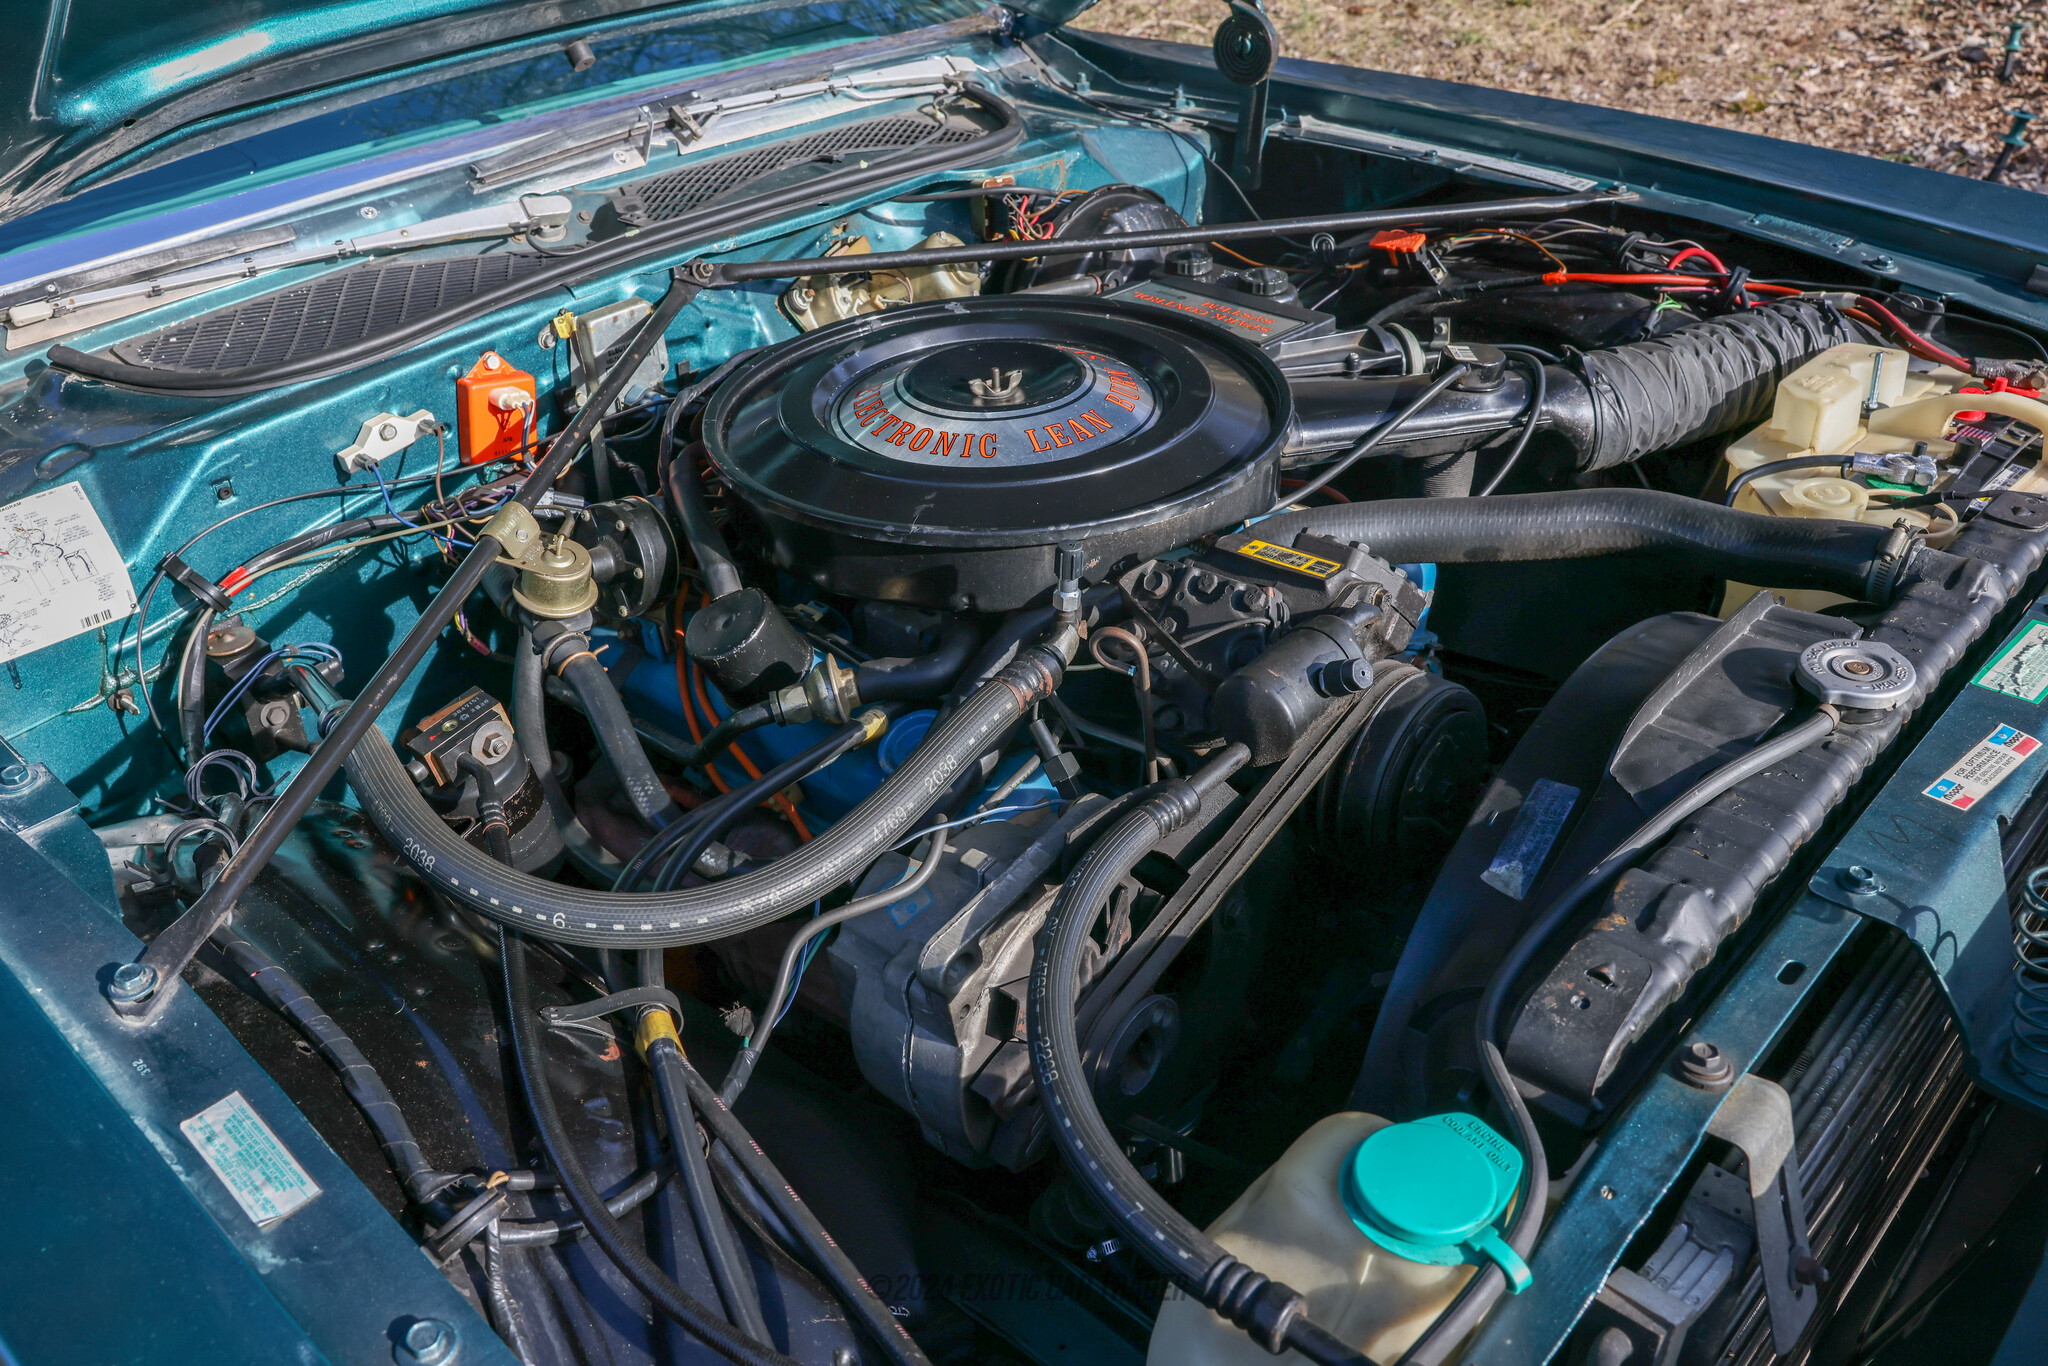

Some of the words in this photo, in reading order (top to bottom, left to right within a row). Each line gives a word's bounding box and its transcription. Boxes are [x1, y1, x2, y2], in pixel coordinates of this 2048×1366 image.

[1133, 291, 1209, 315] CONTROL
[1201, 301, 1276, 325] SYSTEM
[1211, 314, 1273, 333] SPARK
[853, 382, 997, 458] ELECTRONIC
[1024, 409, 1113, 453] LEAN
[1104, 366, 1139, 413] BURN
[1954, 767, 1967, 777] FOR
[1965, 746, 1992, 767] OPTIMUM
[1963, 749, 2000, 780] PERFORMANCE
[871, 804, 907, 843] 4769
[923, 753, 958, 795] 2038
[402, 837, 436, 873] 2038
[1442, 1115, 1487, 1150] COOLANT
[1486, 1150, 1513, 1172] ONLY
[1468, 1120, 1509, 1154] ENGINE
